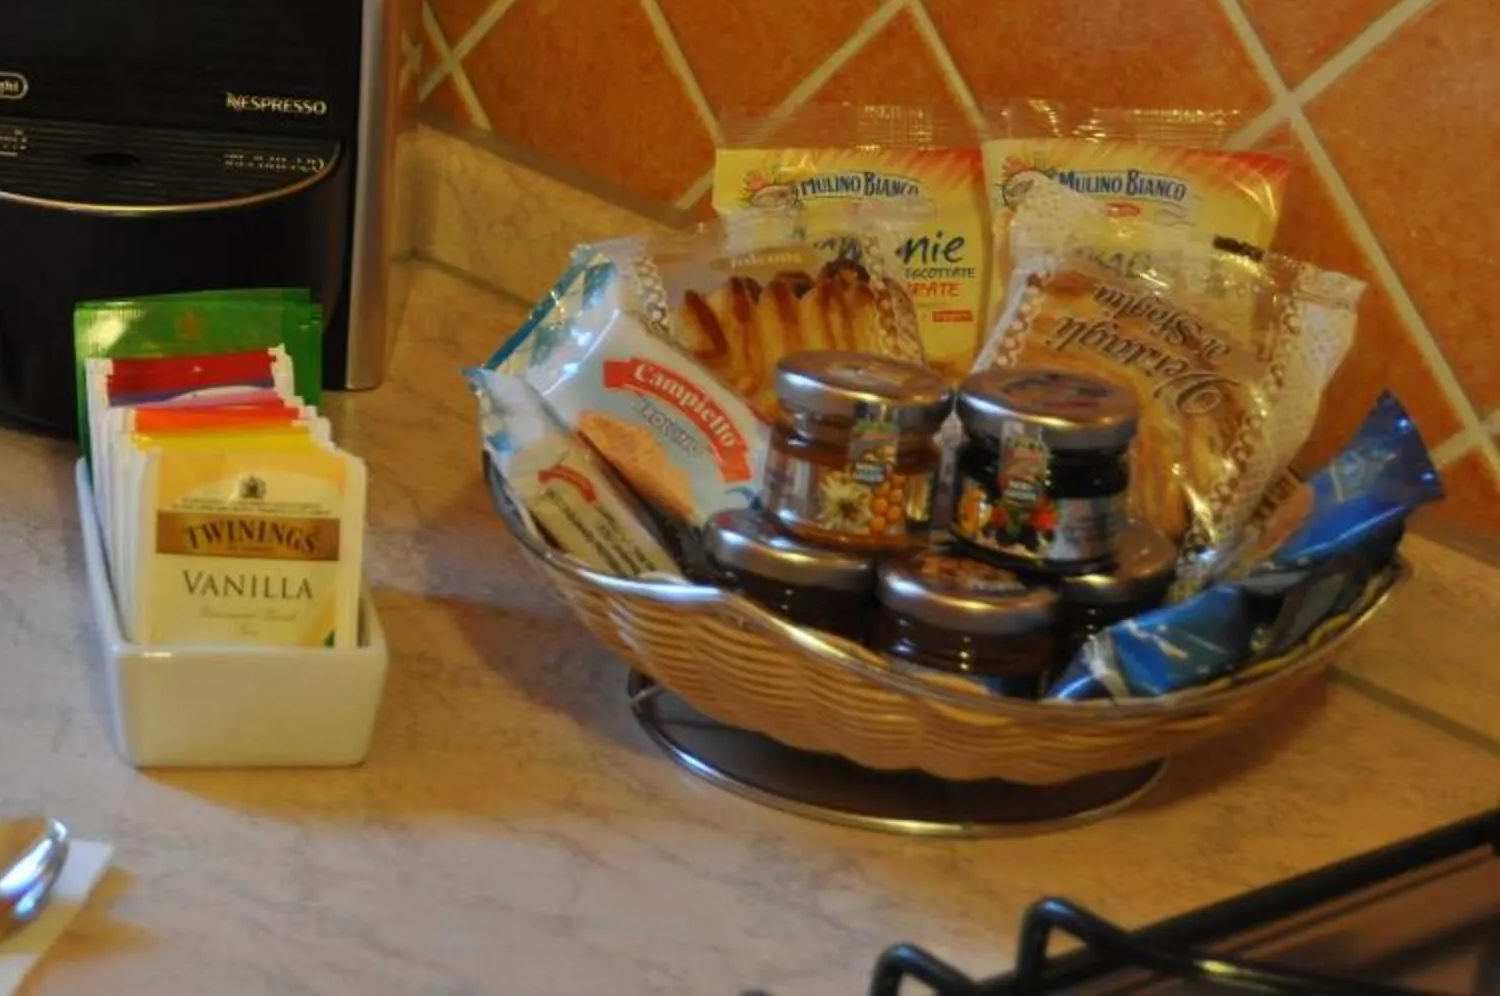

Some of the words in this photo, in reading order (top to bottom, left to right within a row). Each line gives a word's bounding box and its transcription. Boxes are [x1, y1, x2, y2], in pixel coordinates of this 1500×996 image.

[226, 91, 327, 115] NESPRESSO
[801, 175, 861, 196] MULINO
[863, 171, 919, 197] BIANCO
[1058, 169, 1122, 193] MULINO
[1126, 168, 1187, 201] BIANCO
[632, 362, 737, 449] Campiello
[184, 519, 320, 553] TWININGS
[182, 569, 313, 600] VANILLA
